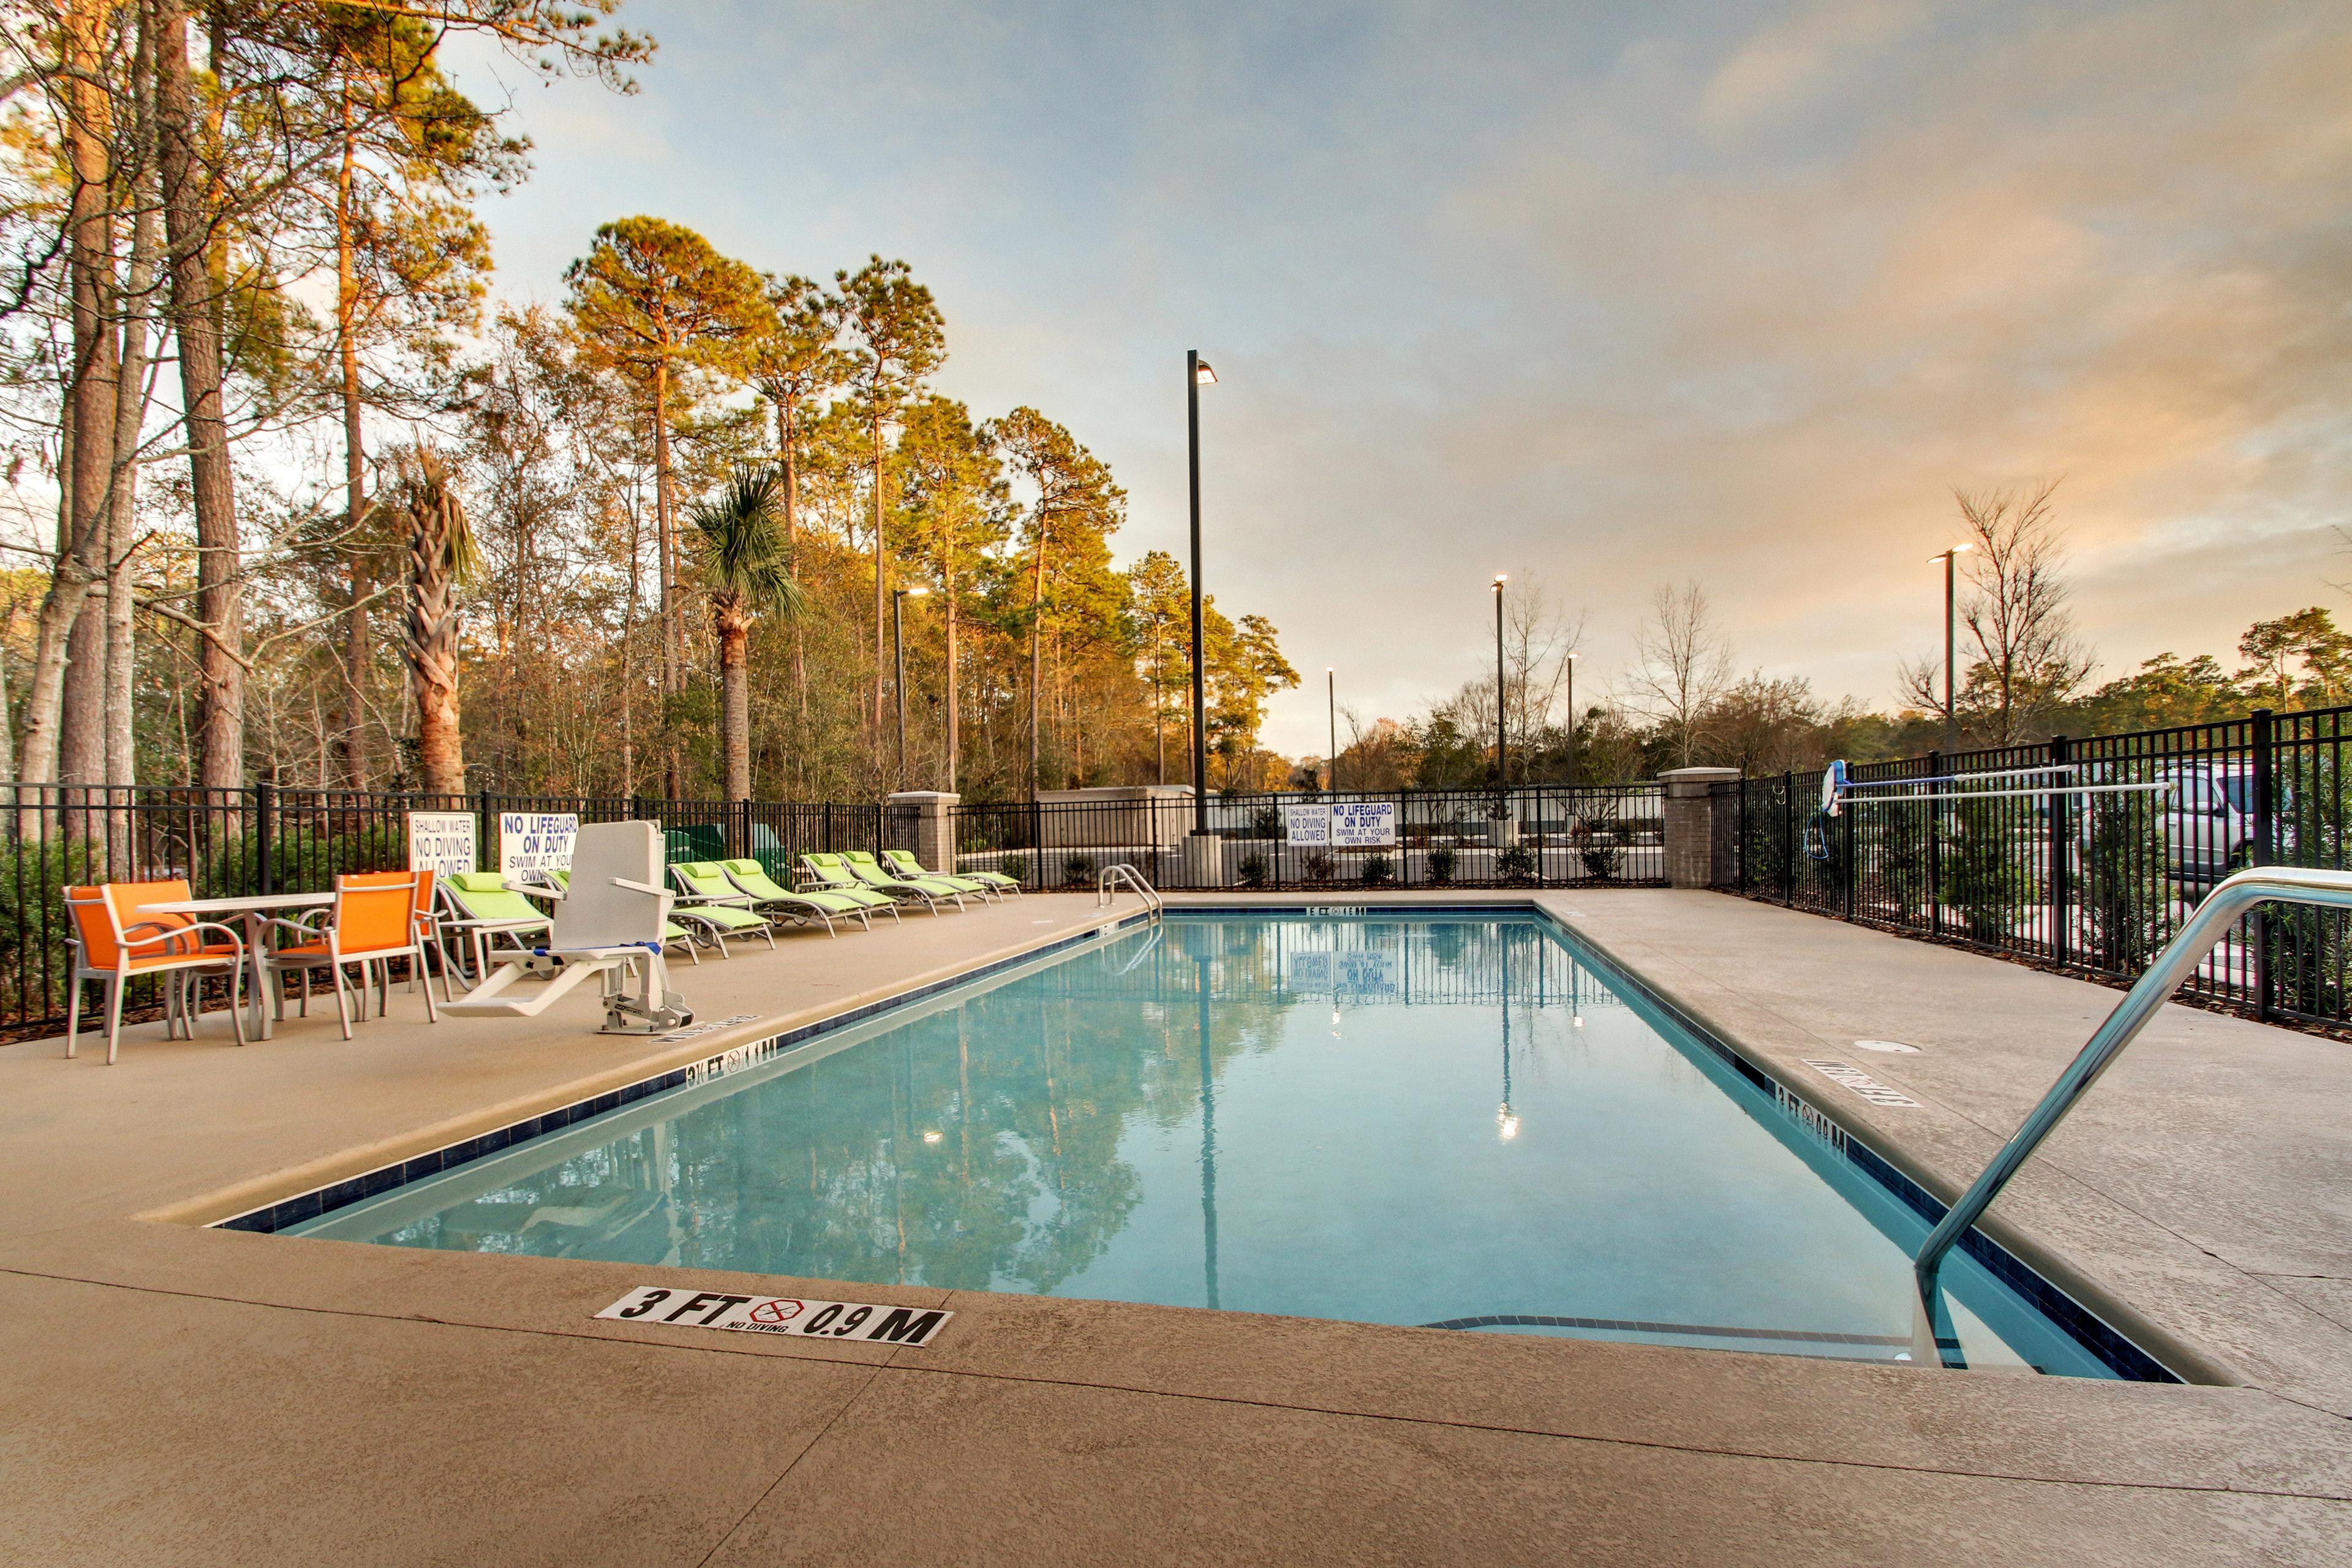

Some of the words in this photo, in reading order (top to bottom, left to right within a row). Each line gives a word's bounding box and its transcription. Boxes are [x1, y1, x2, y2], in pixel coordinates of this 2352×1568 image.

[1333, 805, 1344, 816] NO
[1348, 804, 1392, 816] LIFEGUARD
[415, 820, 447, 833] SHALLOW
[449, 820, 471, 833] WATER
[504, 815, 523, 834] NO
[530, 816, 577, 834] LIFEGUARD
[1291, 818, 1300, 829] NO
[1302, 817, 1325, 829] DIVING
[1344, 817, 1355, 827] ON
[1360, 816, 1381, 827] DUTY
[1291, 830, 1325, 841] ALLOWED
[416, 837, 431, 858] NO
[435, 837, 471, 857] DIVING
[523, 835, 540, 853] ON
[545, 835, 568, 853] DUTY
[509, 856, 536, 869] SWIM
[540, 856, 552, 867] AT
[556, 854, 574, 867] YOU
[521, 869, 544, 881] OWN
[620, 1290, 671, 1318] 3
[663, 1293, 756, 1325] FT
[803, 1304, 873, 1336] 0.9
[866, 1309, 945, 1343] M
[746, 1323, 789, 1333] DIVING
